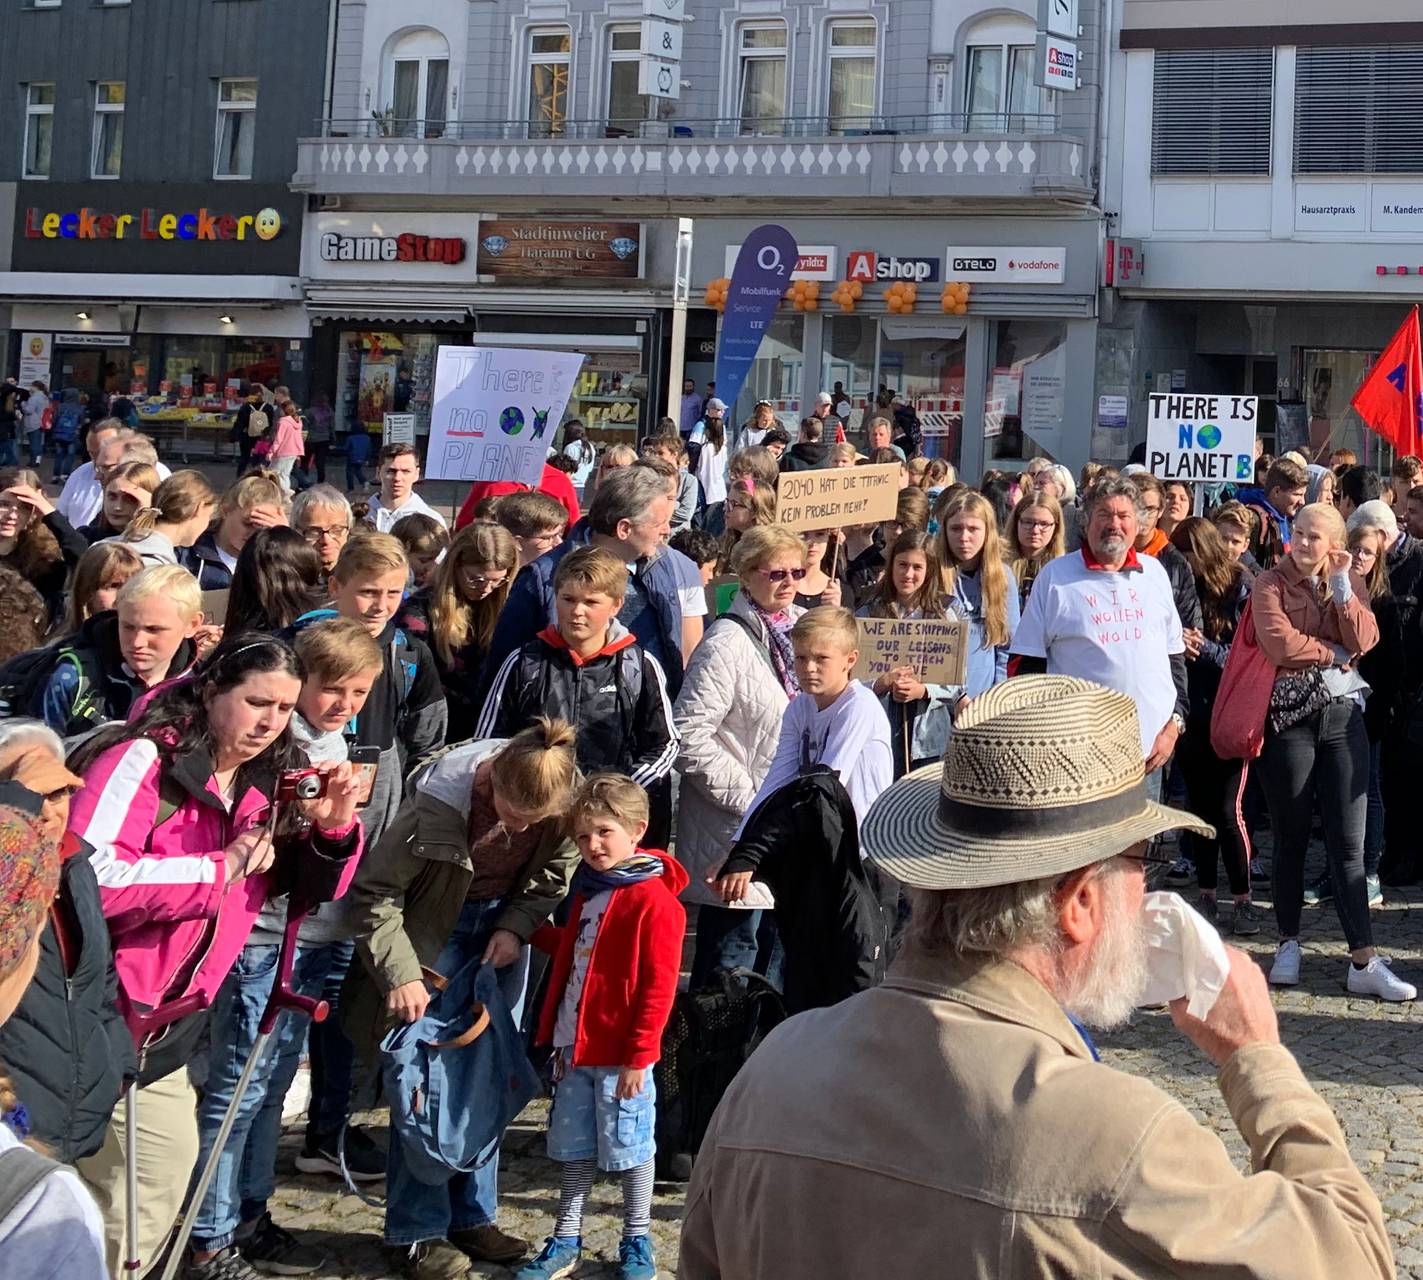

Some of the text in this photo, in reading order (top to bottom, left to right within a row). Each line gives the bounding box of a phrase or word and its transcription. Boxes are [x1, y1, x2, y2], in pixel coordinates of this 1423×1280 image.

[1301, 205, 1356, 215] Hausarztpraxis
[1383, 205, 1392, 214] M.
[25, 207, 253, 241] Lecker Lecker
[511, 226, 608, 242] Stadtjuwelier
[319, 232, 466, 265] GameStop
[575, 247, 596, 260] UG
[1017, 260, 1060, 270] vodafone
[740, 286, 782, 297] Mobilfunk
[750, 320, 765, 329] LTE
[446, 351, 545, 394] There
[1277, 378, 1289, 388] 66
[1150, 395, 1218, 419] THERE
[1230, 397, 1256, 420] IS
[449, 407, 489, 433] no
[1151, 452, 1253, 479] PLANET B
[782, 478, 814, 500] 2040
[820, 477, 839, 493] HAT
[843, 476, 857, 490] DIE
[781, 507, 802, 523] KEIN
[805, 502, 841, 519] PROBLEM
[864, 621, 958, 637] WE ARE SKIPPING
[876, 640, 952, 654] OUR LESSONS
[868, 660, 891, 673] YOU
[881, 653, 945, 665] TO TEACH
